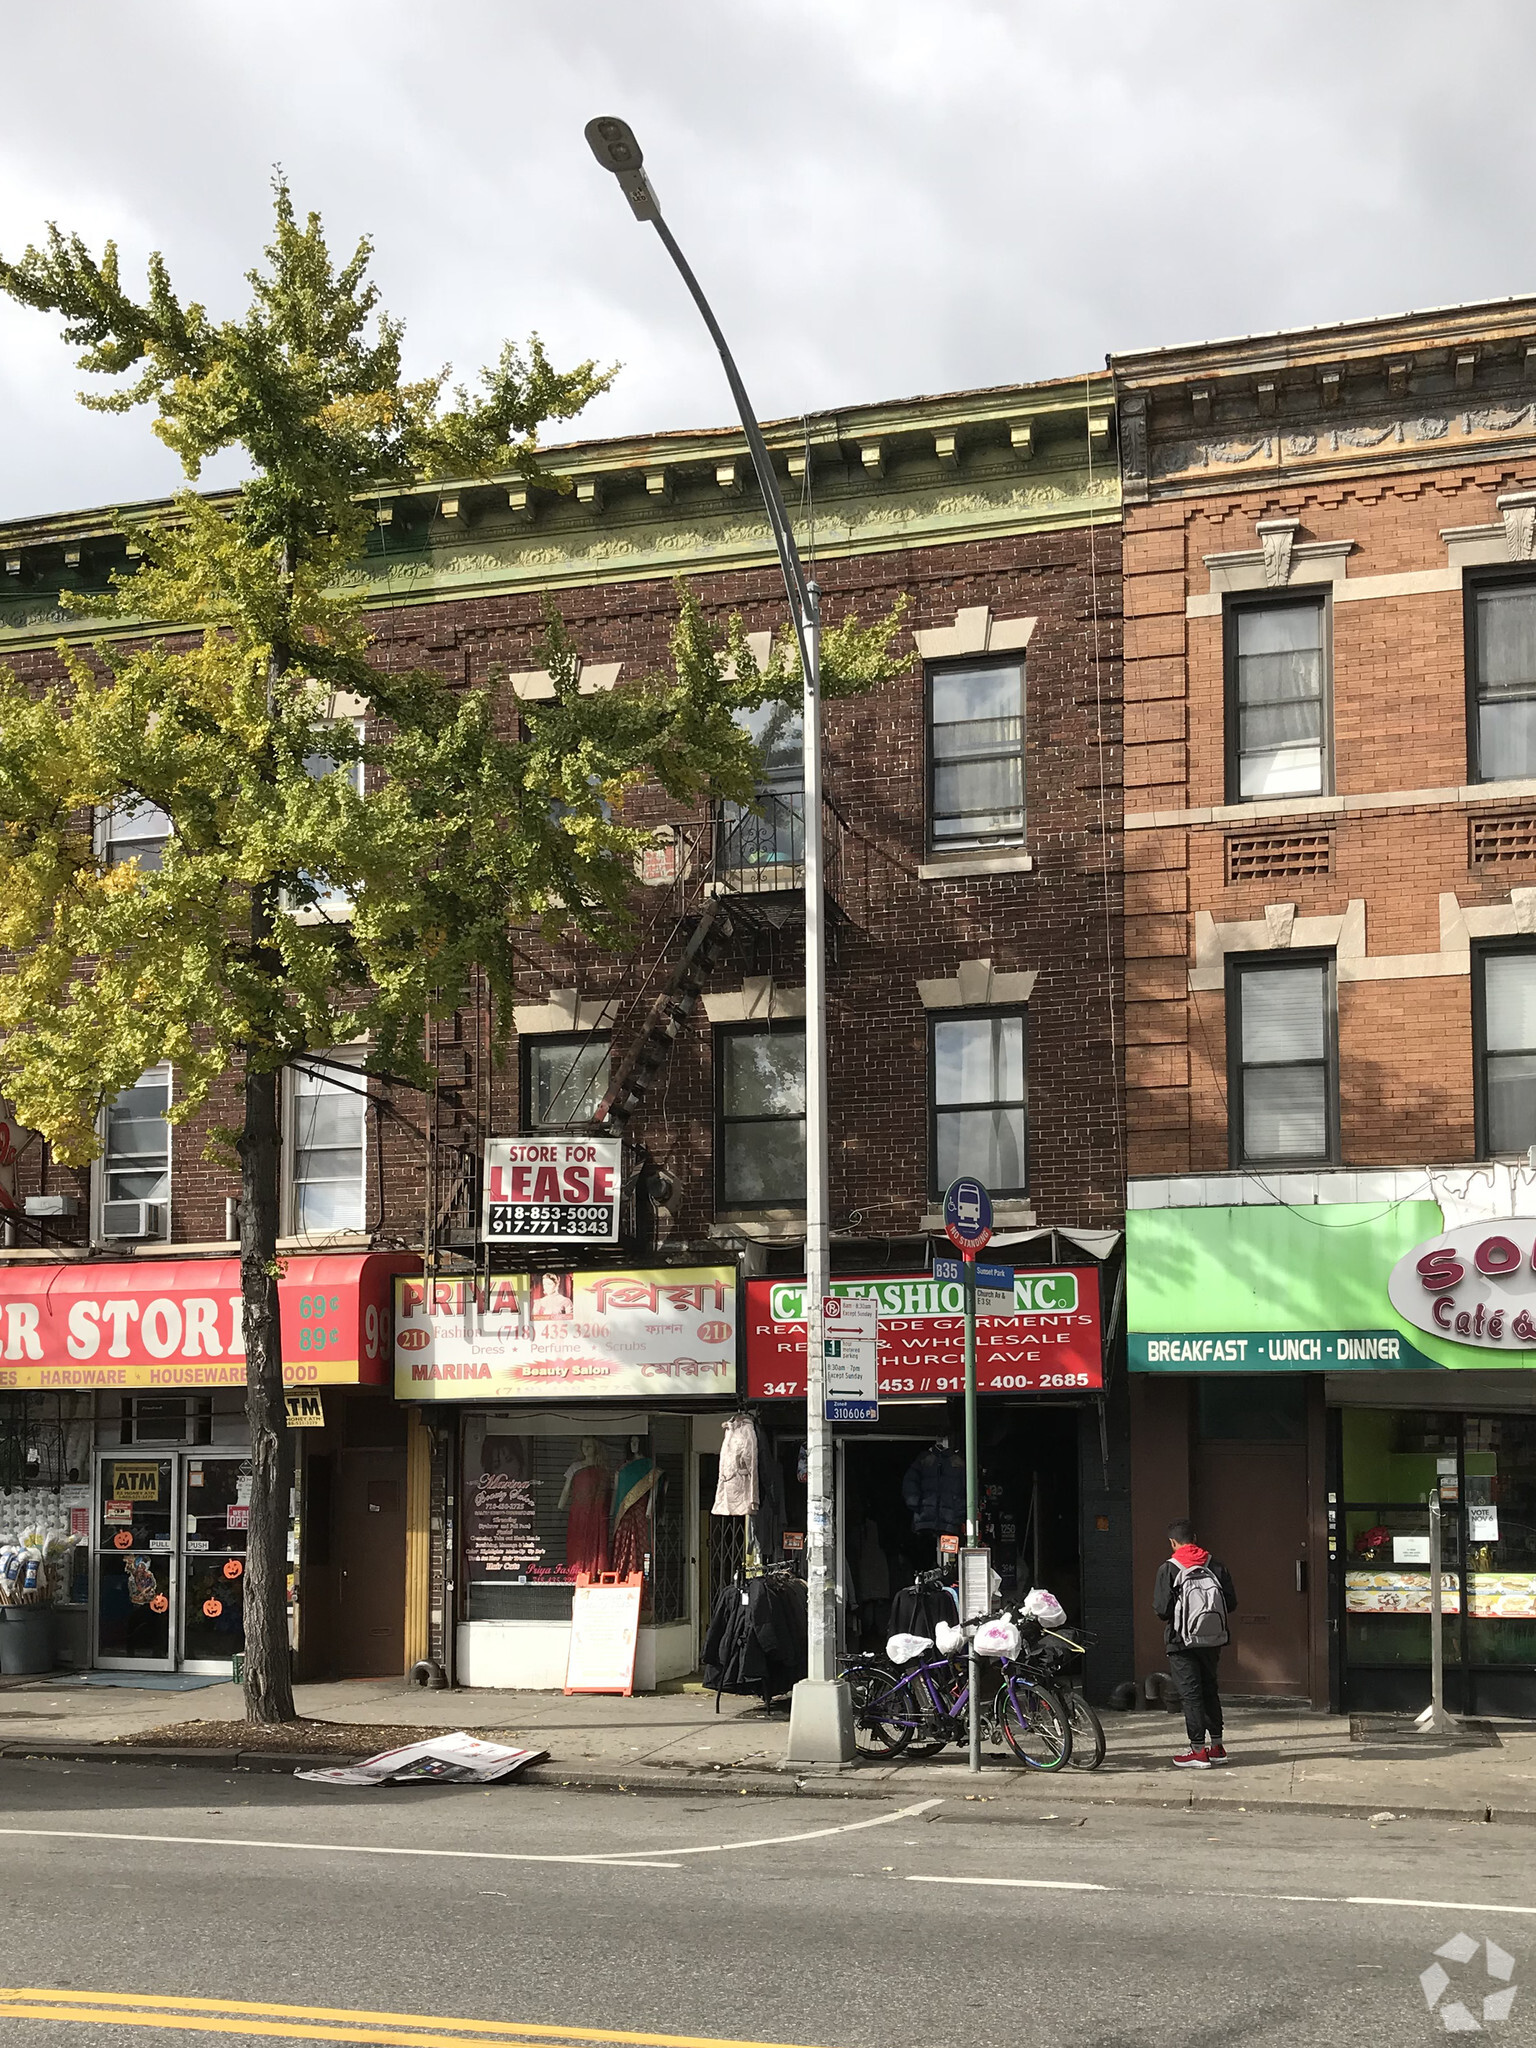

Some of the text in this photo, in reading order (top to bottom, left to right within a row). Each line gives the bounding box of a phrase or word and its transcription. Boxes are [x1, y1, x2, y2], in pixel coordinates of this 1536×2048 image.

[510, 1146, 596, 1162] STORE FOR
[490, 1166, 614, 1203] LEASE
[494, 1206, 608, 1220] 718-853-5000
[492, 1221, 608, 1234] 917-771-3343
[950, 1226, 990, 1248] NO STANDING
[936, 1262, 958, 1279] B35
[1416, 1235, 1536, 1290] SO
[976, 1266, 1006, 1277] Sunset Park
[402, 1280, 521, 1318] PRIYA
[847, 1283, 965, 1316] ASHIO
[977, 1289, 994, 1298] Church
[0, 1303, 44, 1360] R
[434, 1326, 482, 1340] Fashion
[497, 1323, 610, 1343] (718) 435 3206
[702, 1324, 728, 1340] 211
[756, 1315, 1093, 1334] REA ADE GARMENTS
[1512, 1309, 1536, 1340] &
[402, 1332, 426, 1347] 211
[472, 1342, 646, 1354] Dress Perfume Scrubs
[778, 1332, 1071, 1352] RE & WHOLESALE
[830, 1340, 836, 1356] 1
[1148, 1340, 1248, 1362] BREAKFAST
[1268, 1338, 1321, 1360] LUNCH
[1337, 1338, 1400, 1360] DINNER
[877, 1352, 1041, 1366] HURCH AVE
[40, 1370, 126, 1384] HARDWARE
[150, 1366, 248, 1384] HOUSEWARE
[284, 1366, 318, 1381] OOD
[412, 1363, 492, 1381] MARINA
[522, 1364, 610, 1380] Beauty Salon
[828, 1372, 863, 1380] Except Sunday
[850, 1364, 860, 1372] 7pm
[764, 1382, 798, 1396] 347
[878, 1378, 915, 1392] 453
[1039, 1373, 1089, 1388] 2685
[285, 1398, 320, 1416] TM
[834, 1408, 865, 1418] 310606
[115, 1472, 156, 1490] ATM
[477, 1473, 530, 1490] Marina
[474, 1489, 535, 1506] Beauty Salon
[229, 1516, 249, 1528] OPE
[526, 1564, 585, 1576] Priya Fashi
